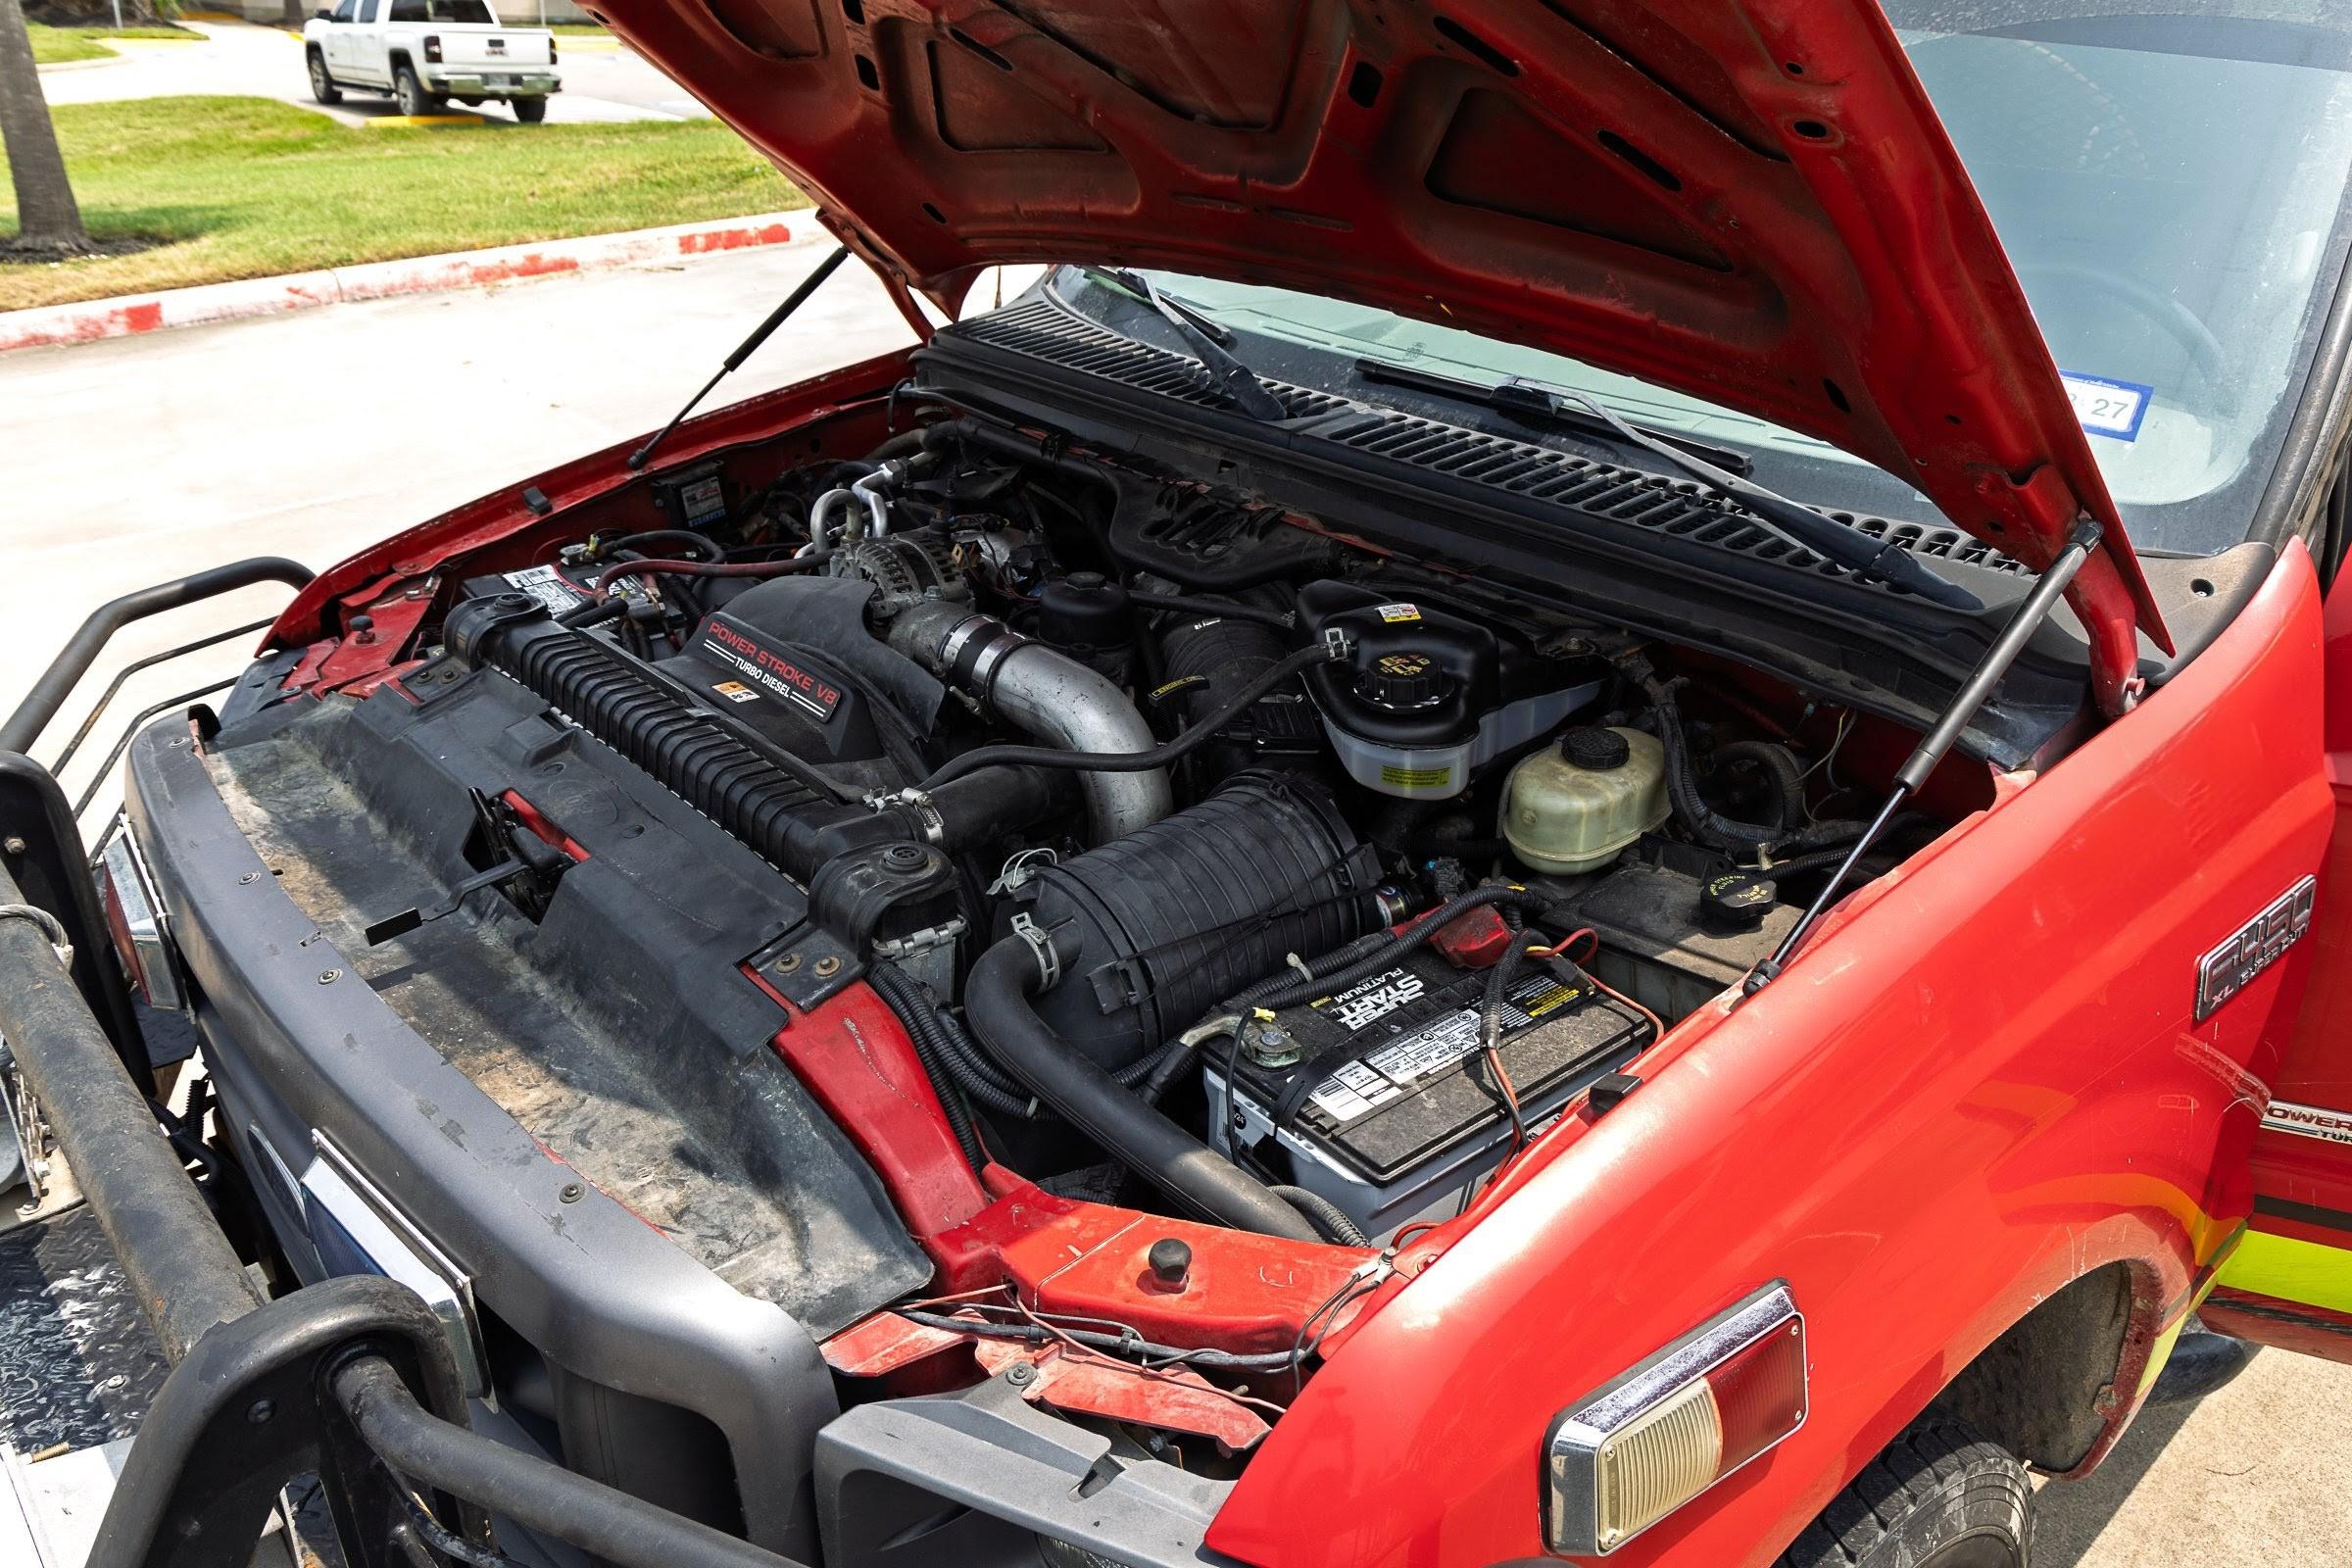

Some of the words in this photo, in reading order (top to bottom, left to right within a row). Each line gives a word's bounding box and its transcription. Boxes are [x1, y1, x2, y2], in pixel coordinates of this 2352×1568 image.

[2090, 398, 2129, 419] 27
[708, 621, 758, 659] POWER
[757, 650, 815, 692] STROKE
[815, 683, 841, 707] V8
[735, 657, 762, 679] TURBO
[761, 673, 792, 699] DIESEL
[1334, 967, 1404, 1004] PLATINUM
[2209, 985, 2234, 1009] XL
[2240, 947, 2280, 986] SUPER
[2280, 922, 2309, 953] DUTY
[1337, 974, 1424, 1024] START
[1346, 989, 1426, 1031] SUPER
